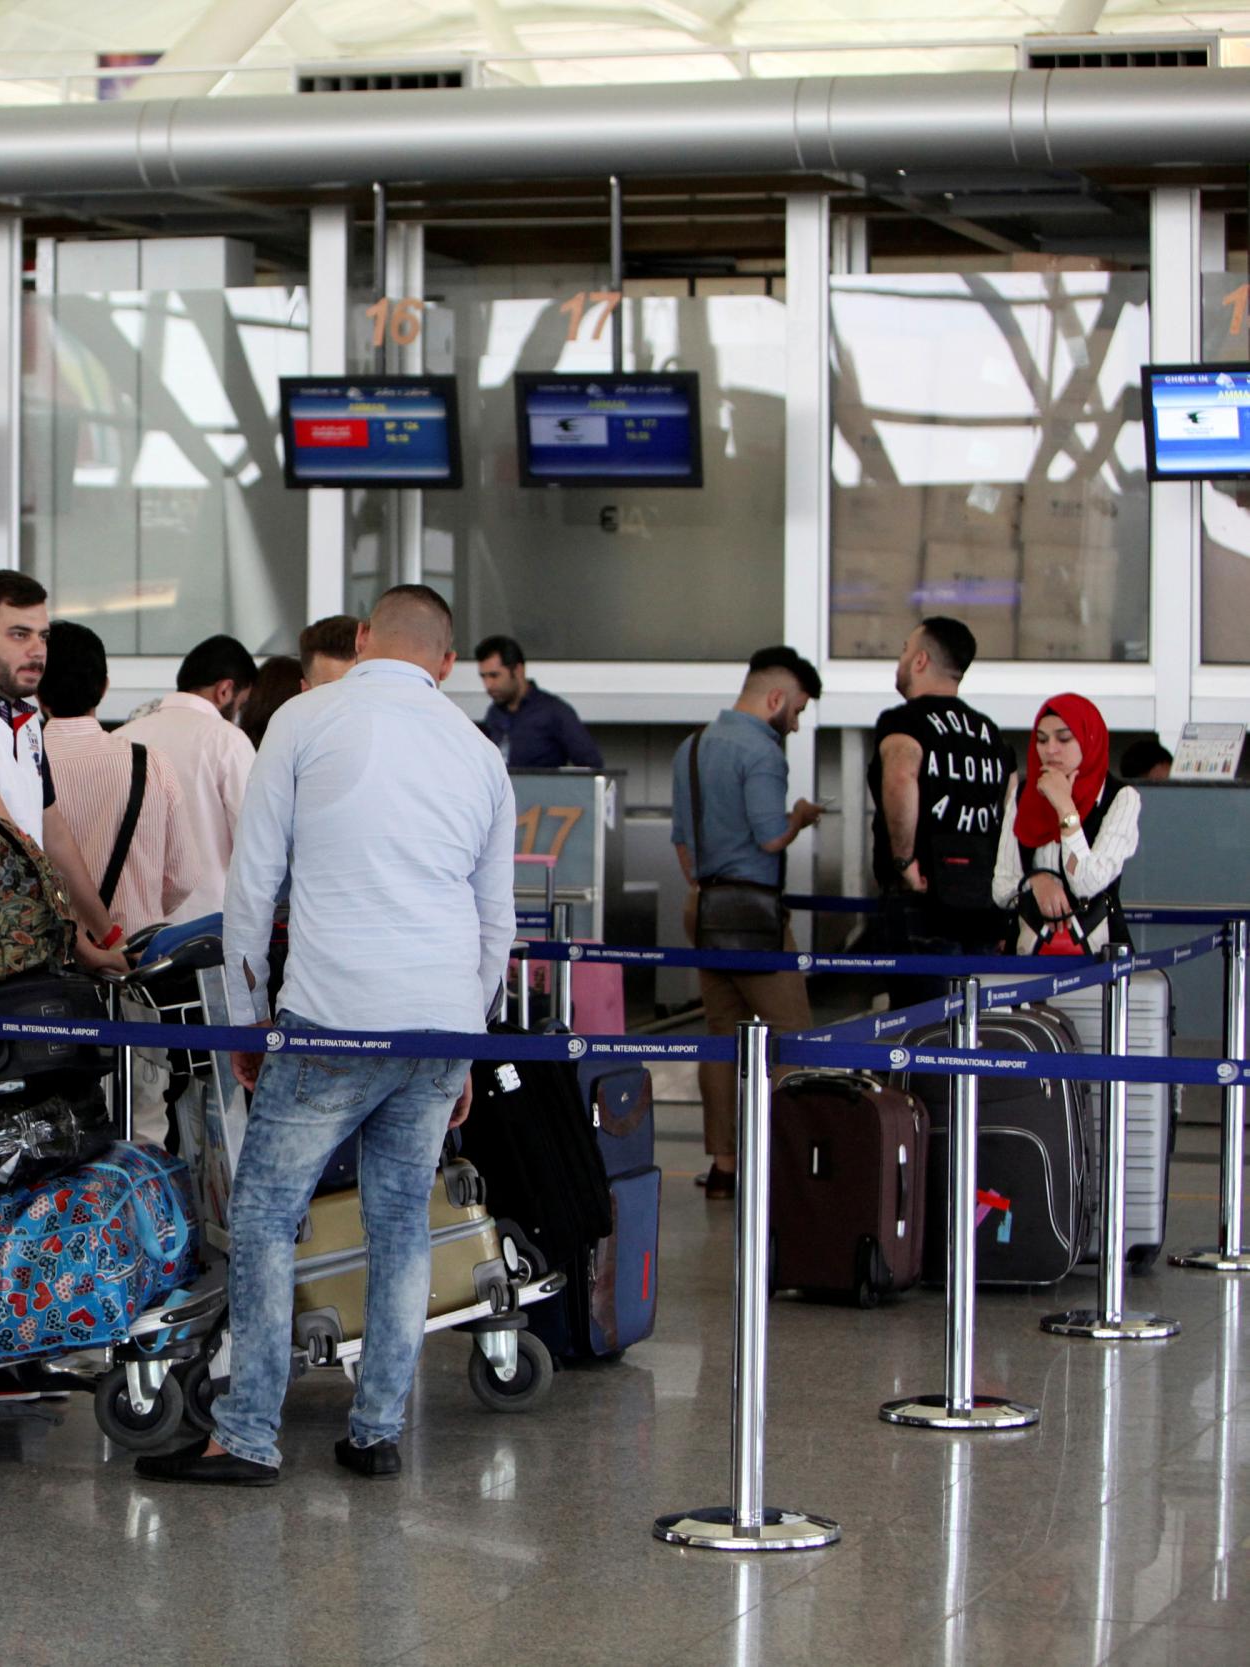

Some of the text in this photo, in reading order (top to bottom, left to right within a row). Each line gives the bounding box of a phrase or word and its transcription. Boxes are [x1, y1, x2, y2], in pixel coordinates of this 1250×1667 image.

[366, 296, 424, 347] 16
[560, 292, 622, 341] 17
[1165, 375, 1208, 384] CHECK IN
[926, 710, 991, 744] HOLA
[517, 804, 584, 857] 17
[2, 1024, 21, 1032] ERBIL
[22, 1025, 70, 1035] INTERNATIONAL
[71, 1028, 99, 1036] AIRPORT
[290, 1038, 308, 1046] ERBIL
[310, 1039, 360, 1048] INTERNATIONAL
[614, 1044, 666, 1053] INTERNATIONAL
[668, 1045, 698, 1053] AIRPORT
[915, 1055, 936, 1064] ERBIL
[938, 1056, 994, 1068] INTERNATIONAL
[995, 1060, 1027, 1069] AIRPORT
